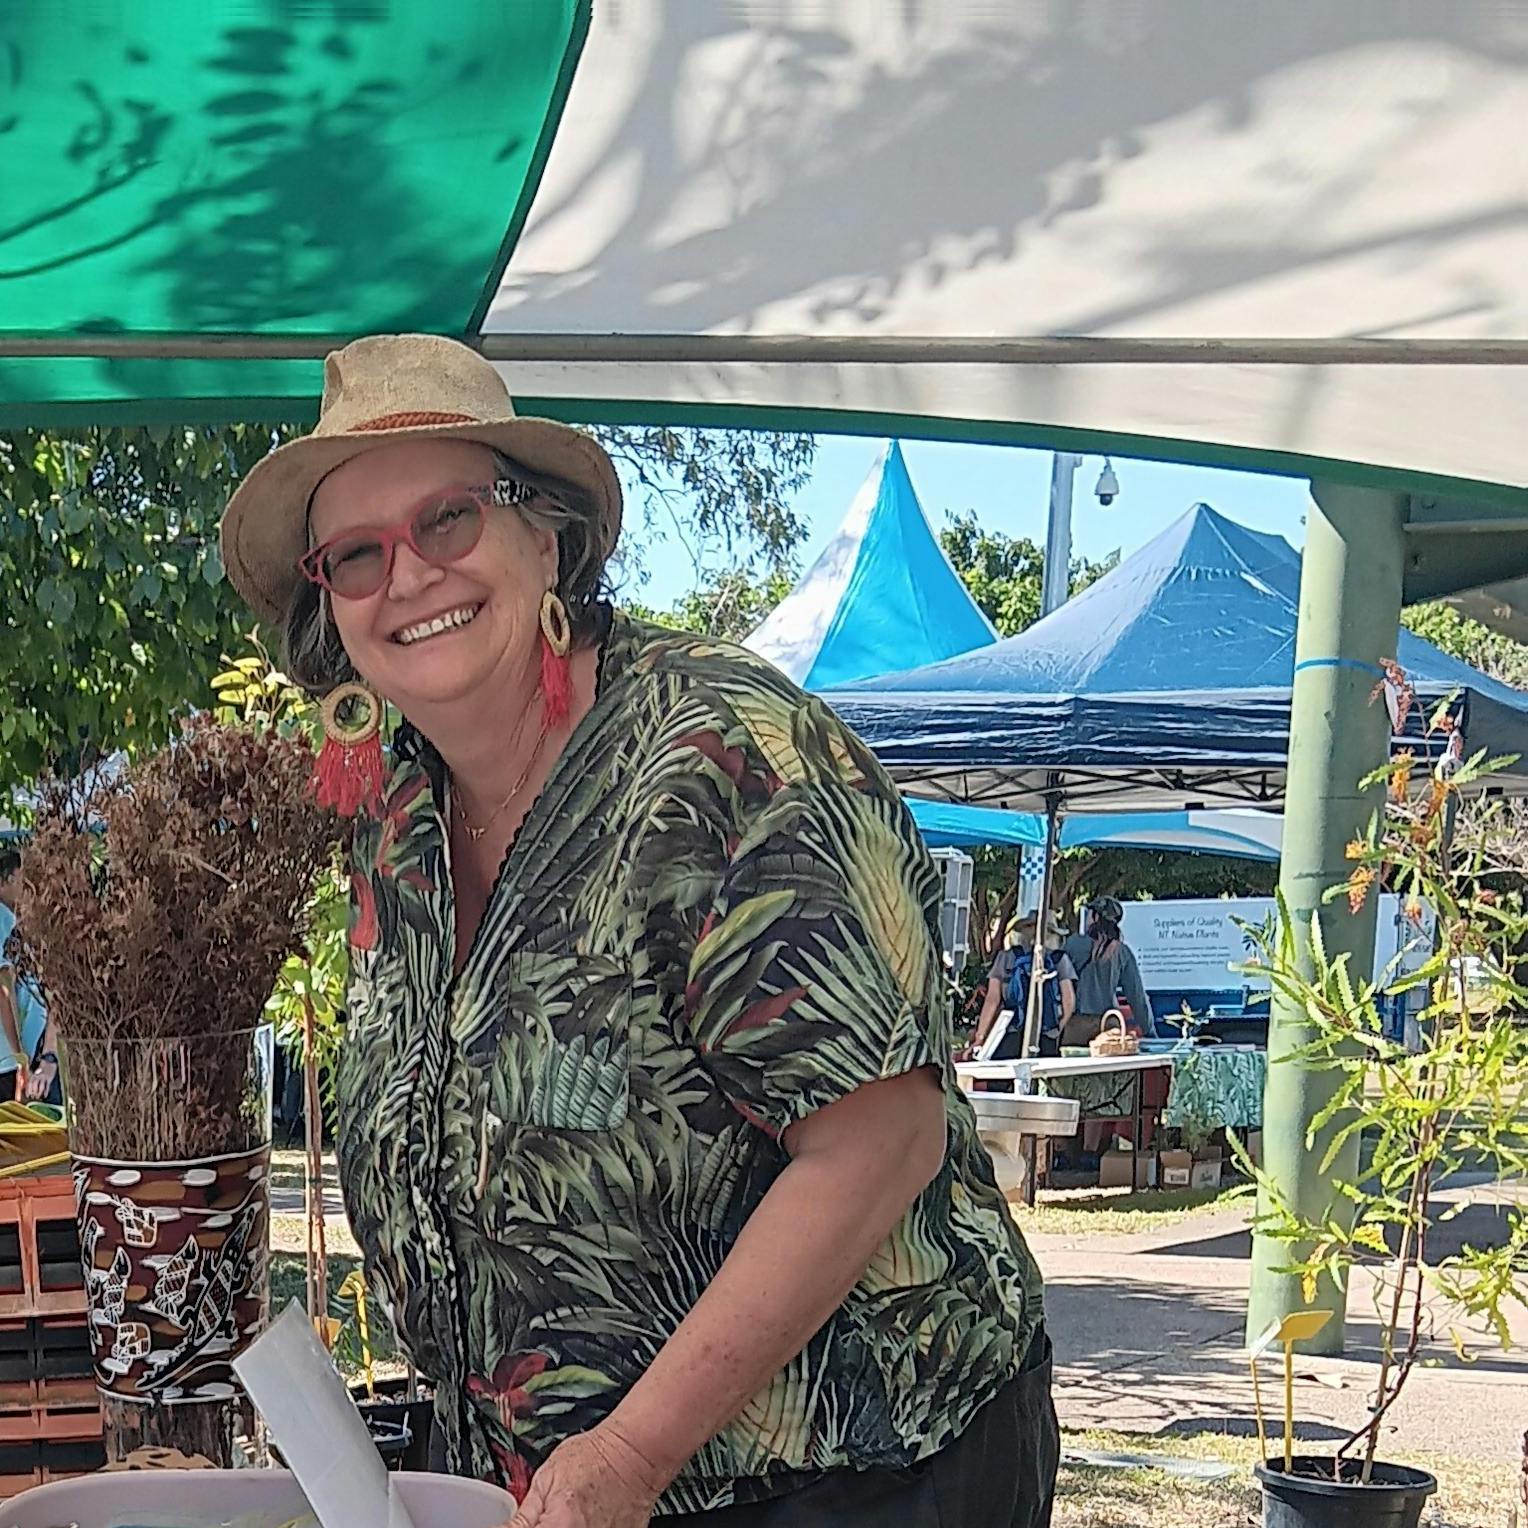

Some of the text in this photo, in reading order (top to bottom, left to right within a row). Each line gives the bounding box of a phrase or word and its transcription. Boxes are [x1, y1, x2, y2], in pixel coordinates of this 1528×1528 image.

[1153, 915, 1223, 931] Suppliers of Quality
[1158, 928, 1219, 939] NT Native Plants
